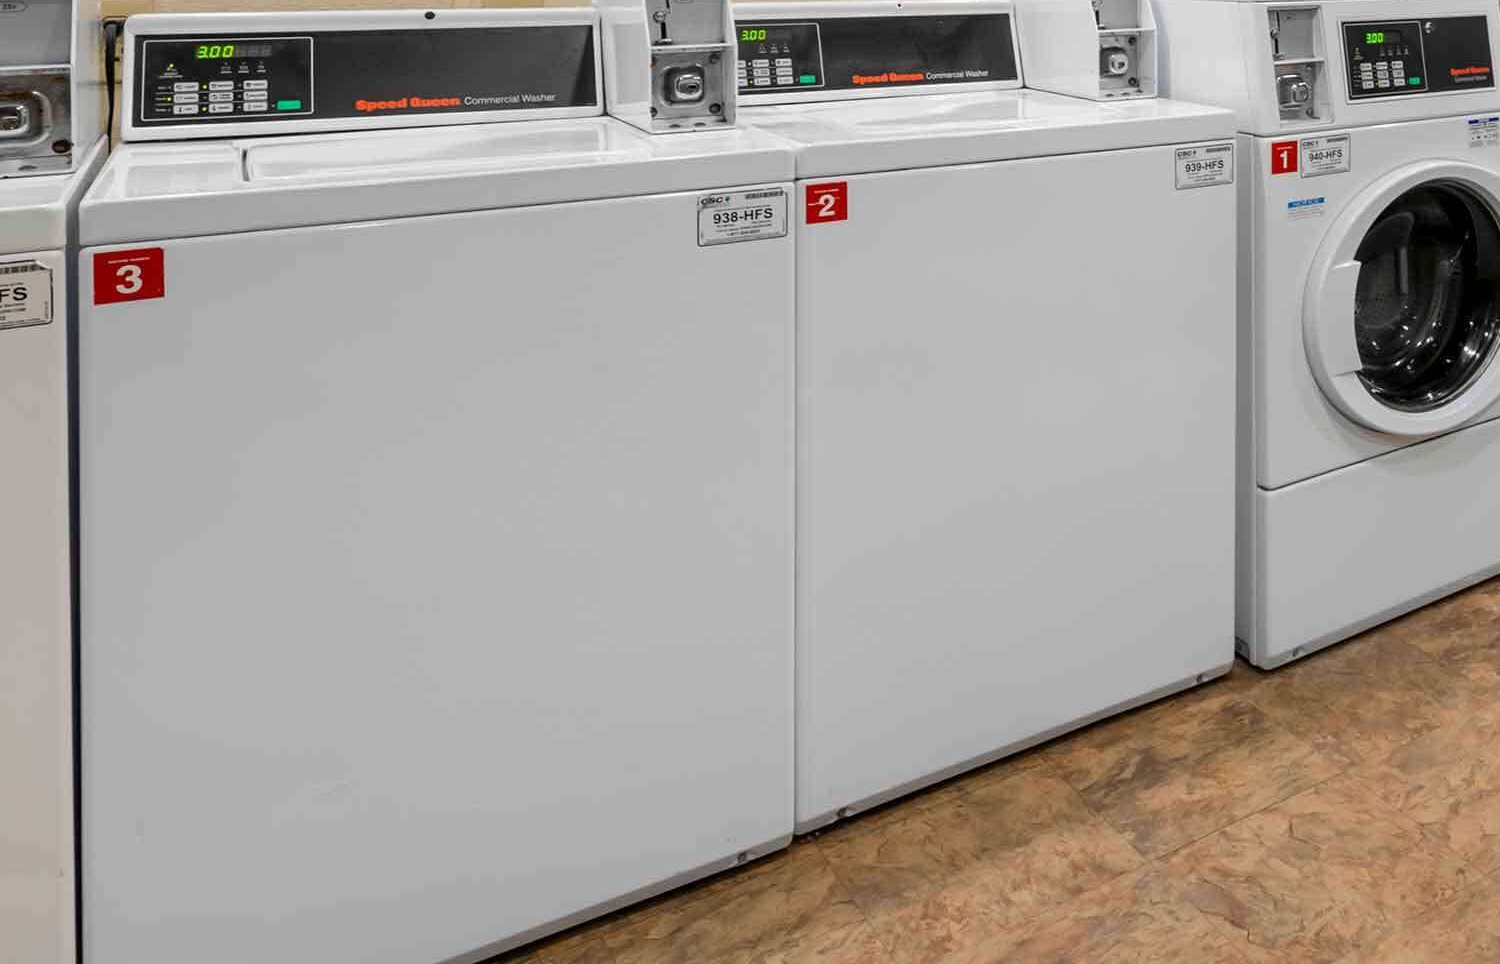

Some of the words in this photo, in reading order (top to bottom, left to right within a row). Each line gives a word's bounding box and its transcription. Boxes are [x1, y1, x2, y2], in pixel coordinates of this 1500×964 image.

[197, 44, 235, 59] 3.00
[354, 98, 407, 112] Speed
[410, 96, 460, 108] Queen
[464, 95, 519, 106] Commercial
[522, 94, 556, 103] Washer
[1280, 150, 1288, 169] 1
[818, 194, 836, 217] 2
[713, 208, 773, 224] 938-HFS
[115, 264, 142, 294] 3
